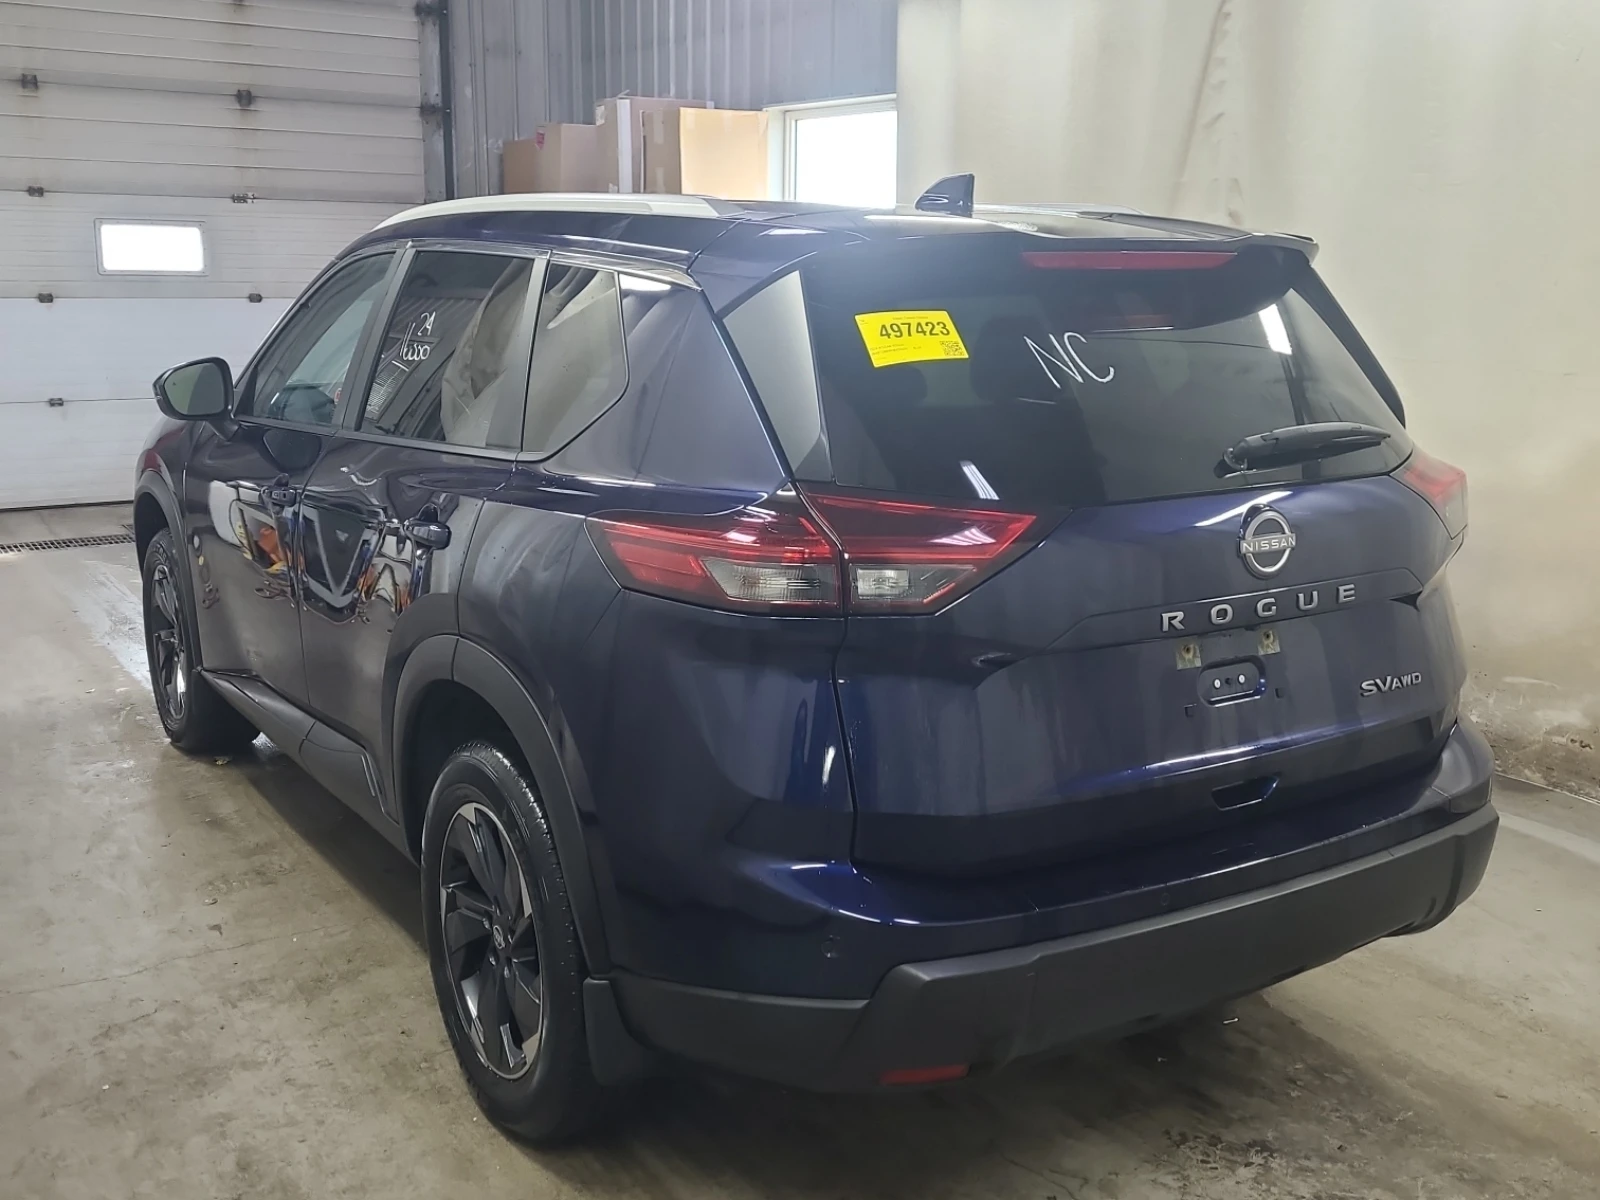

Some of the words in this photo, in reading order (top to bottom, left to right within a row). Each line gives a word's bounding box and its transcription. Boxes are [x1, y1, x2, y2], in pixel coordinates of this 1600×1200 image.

[417, 311, 436, 336] 24
[879, 321, 950, 339] 497423
[1023, 330, 1115, 389] NC
[1242, 534, 1296, 551] NISSAN
[1161, 584, 1356, 632] ROGUE
